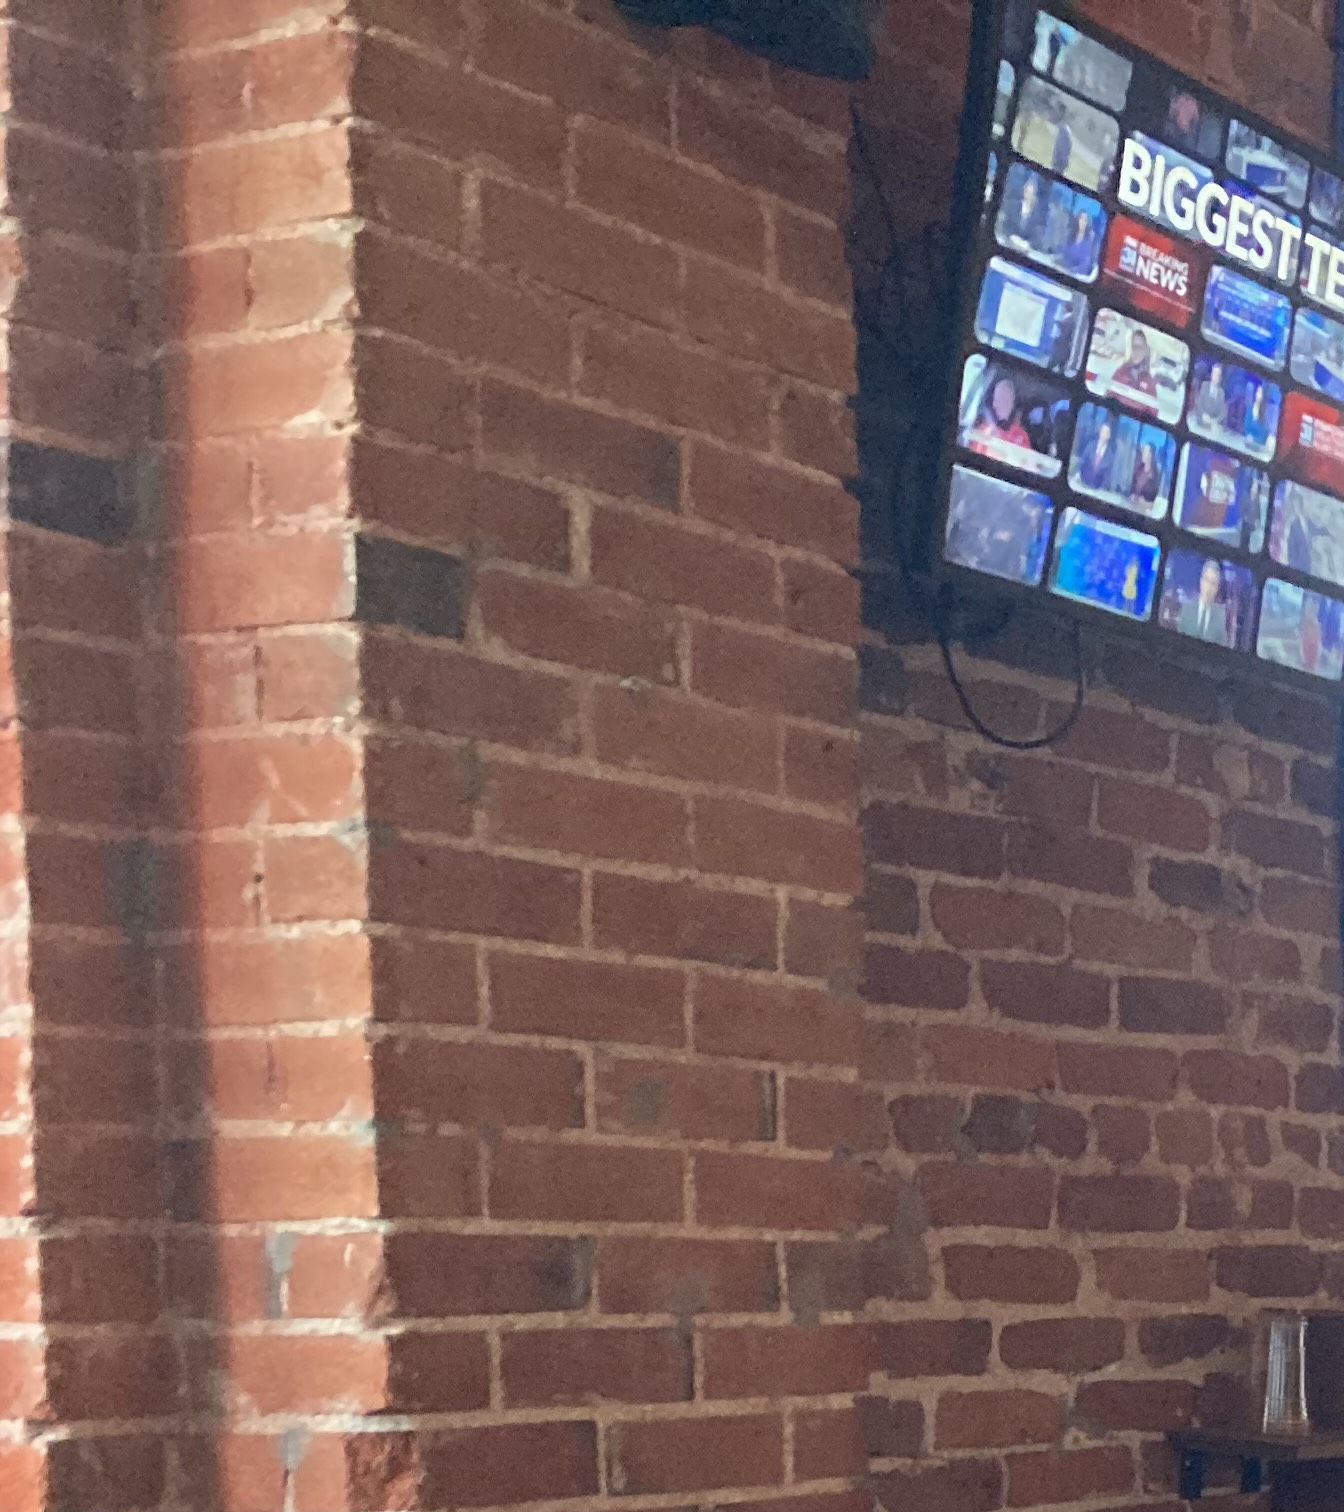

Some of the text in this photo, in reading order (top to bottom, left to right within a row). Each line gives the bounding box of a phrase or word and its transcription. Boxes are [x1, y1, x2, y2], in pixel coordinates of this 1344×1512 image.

[1118, 138, 1301, 281] BIGGEST
[1135, 255, 1189, 296] NEWS
[1140, 242, 1189, 276] BREAKING
